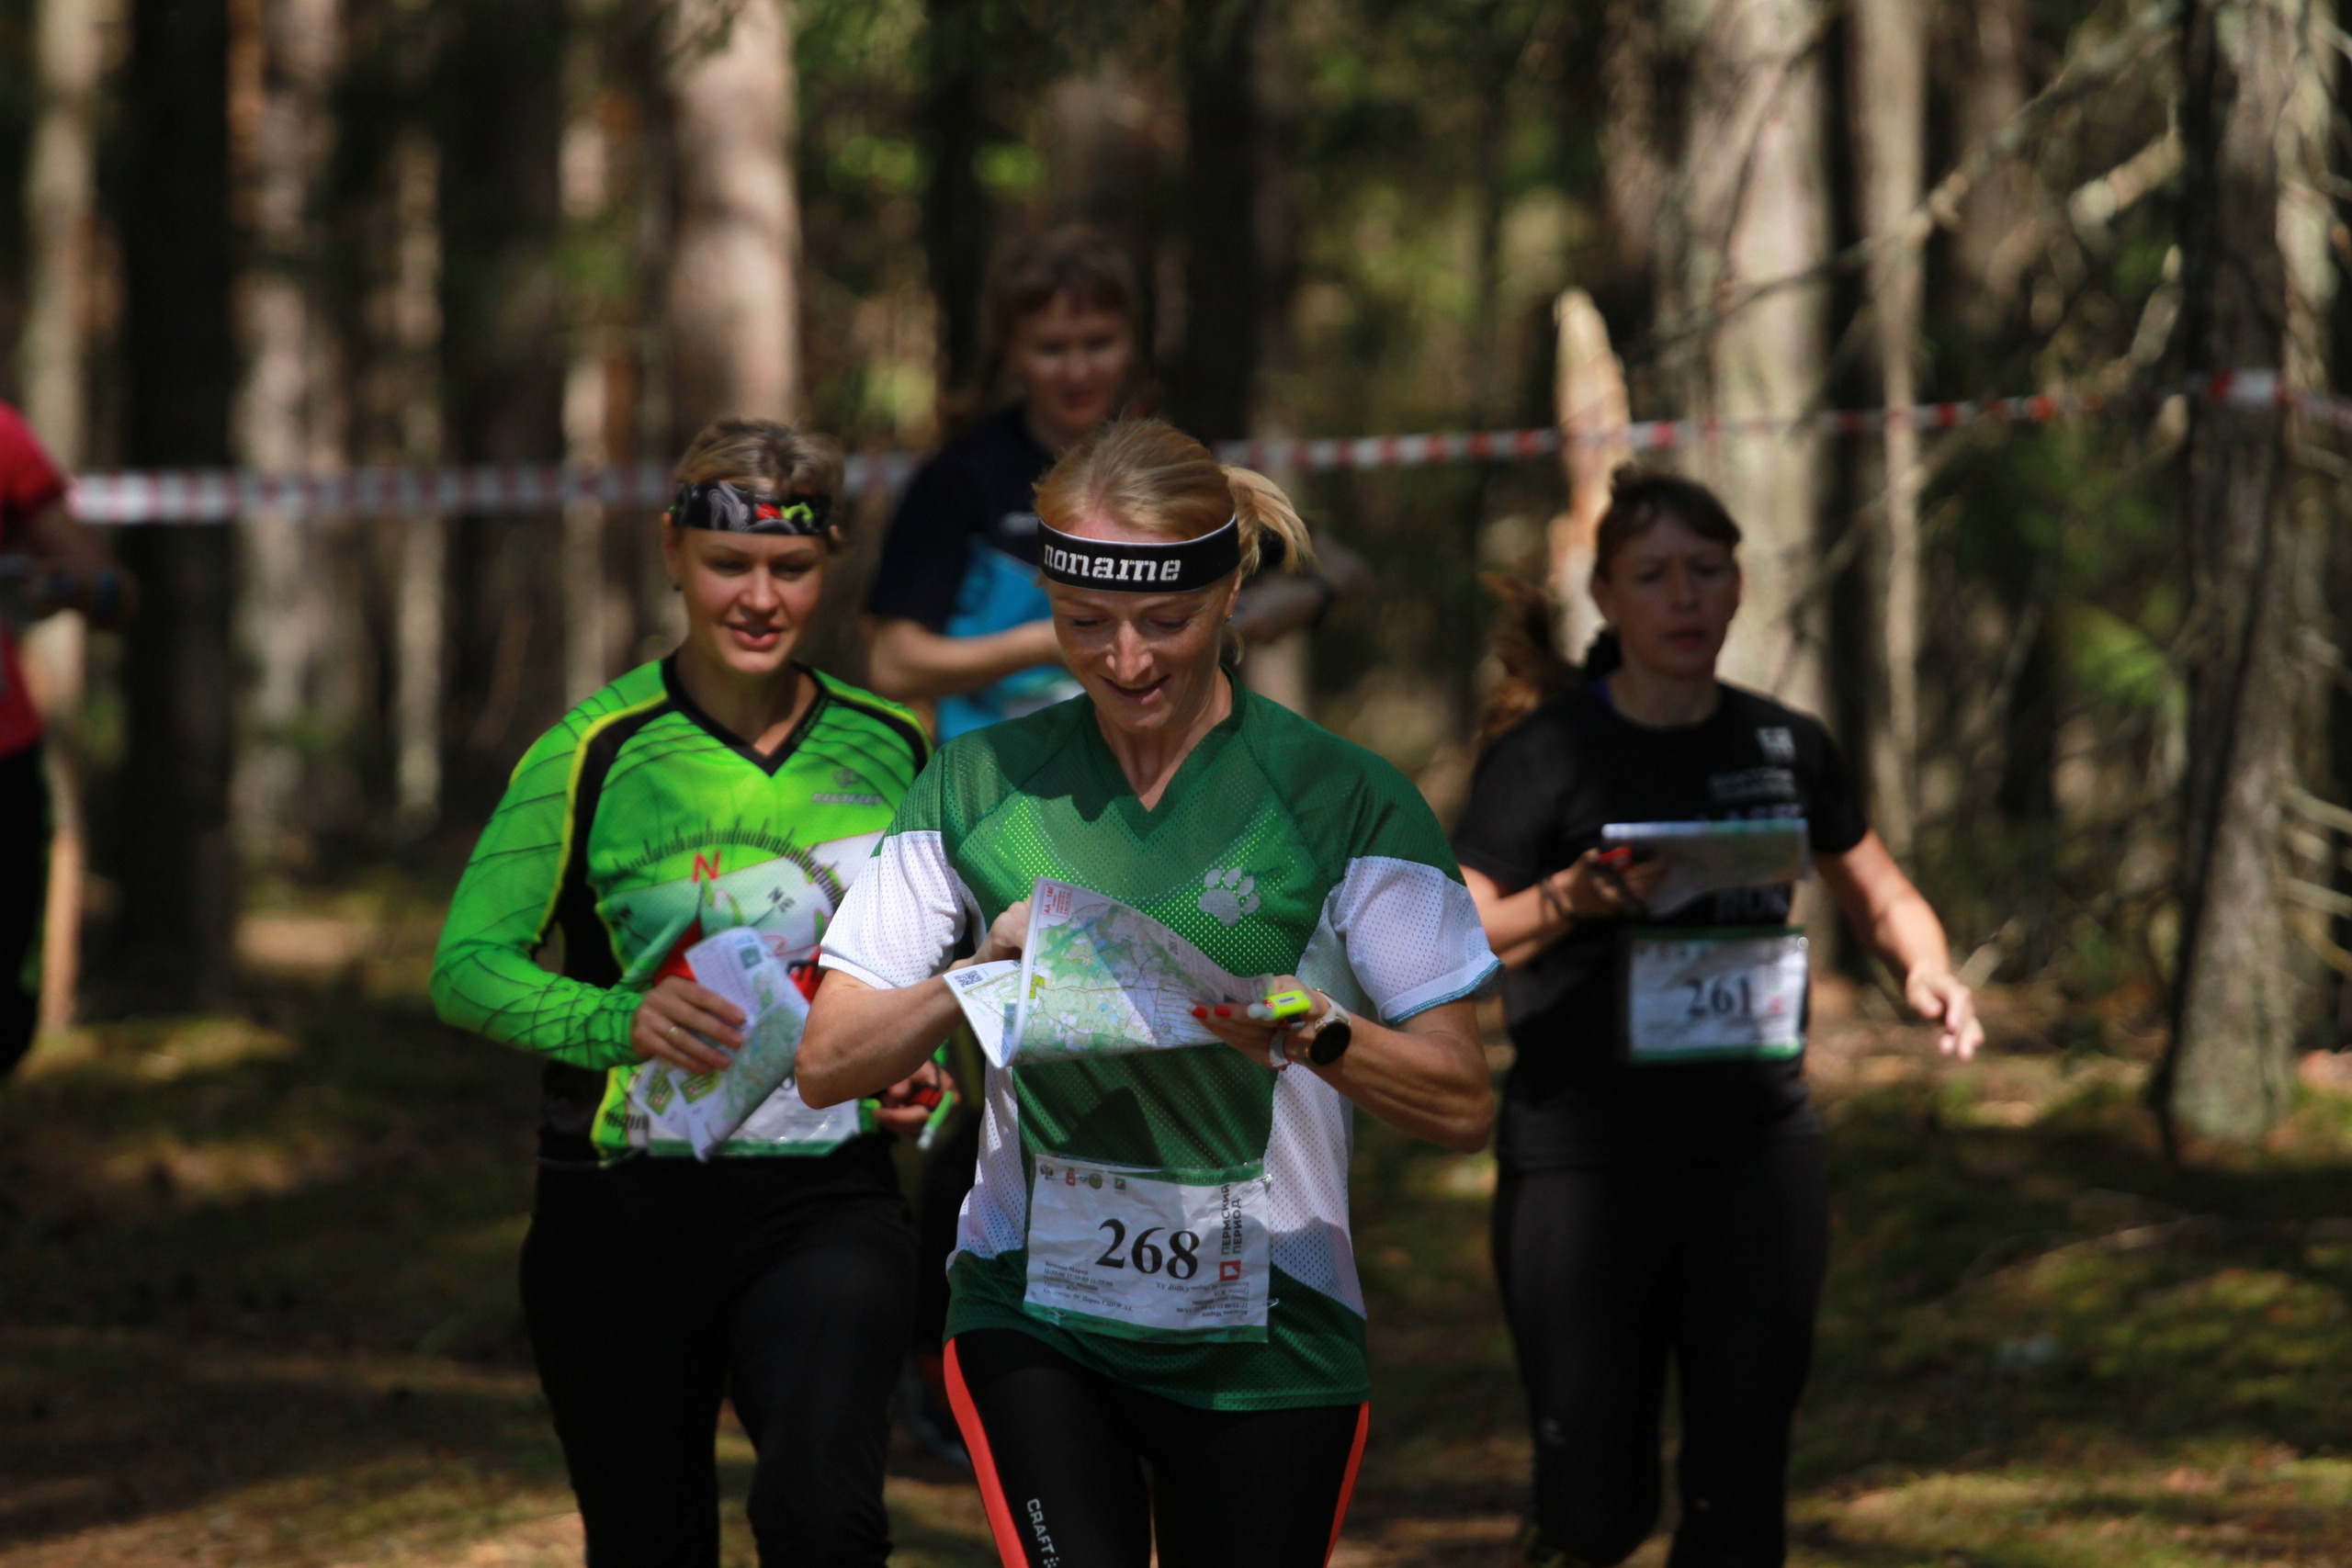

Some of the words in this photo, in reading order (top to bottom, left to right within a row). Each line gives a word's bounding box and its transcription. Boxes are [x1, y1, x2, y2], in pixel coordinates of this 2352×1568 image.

[1043, 544, 1182, 581] noname
[692, 851, 720, 883] N
[1685, 976, 1752, 1019] 261
[1221, 1183, 1231, 1256] ПЕРМСКИЙ
[1232, 1198, 1243, 1255] ПЕРИОД
[1095, 1218, 1200, 1280] 268
[1027, 1498, 1055, 1554] CRAFT
